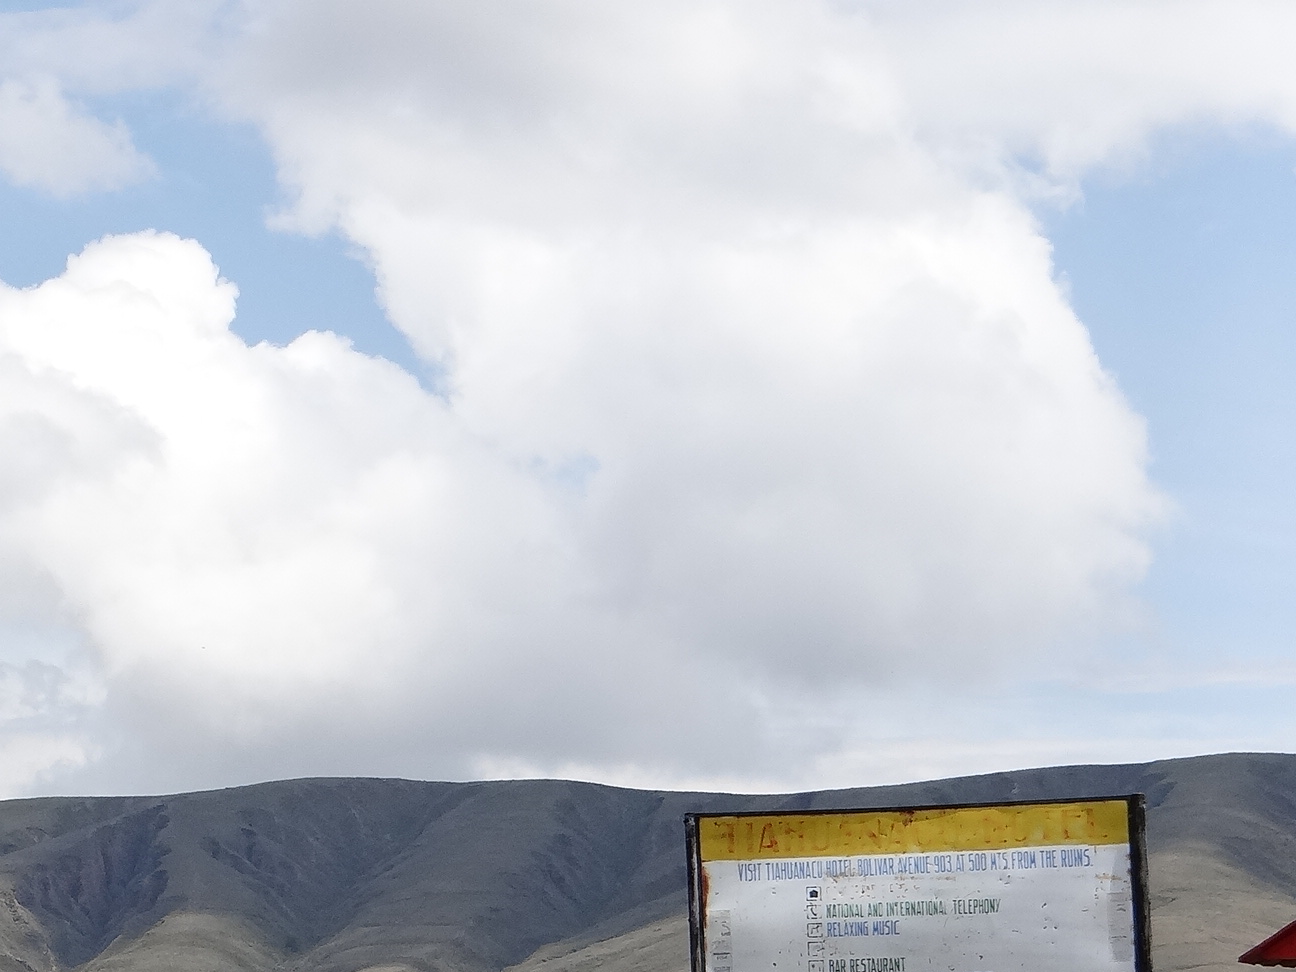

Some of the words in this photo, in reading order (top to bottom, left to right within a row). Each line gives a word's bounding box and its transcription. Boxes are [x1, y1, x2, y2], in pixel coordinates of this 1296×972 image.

[737, 862, 762, 882] VISIT
[765, 860, 823, 881] TIAHUANACU
[825, 859, 854, 878] HOTEL
[857, 857, 895, 877] BOLIVAR
[897, 855, 931, 875] AVENUE
[955, 854, 965, 872] AT
[968, 852, 987, 871] 500
[1011, 850, 1037, 870] FROM
[1039, 849, 1057, 868] THE
[826, 903, 864, 919] NATIONAL
[867, 902, 883, 917] AND
[886, 900, 947, 917] INTERNATIONAL
[827, 920, 869, 938] RELAXING
[872, 919, 900, 937] MUSIC
